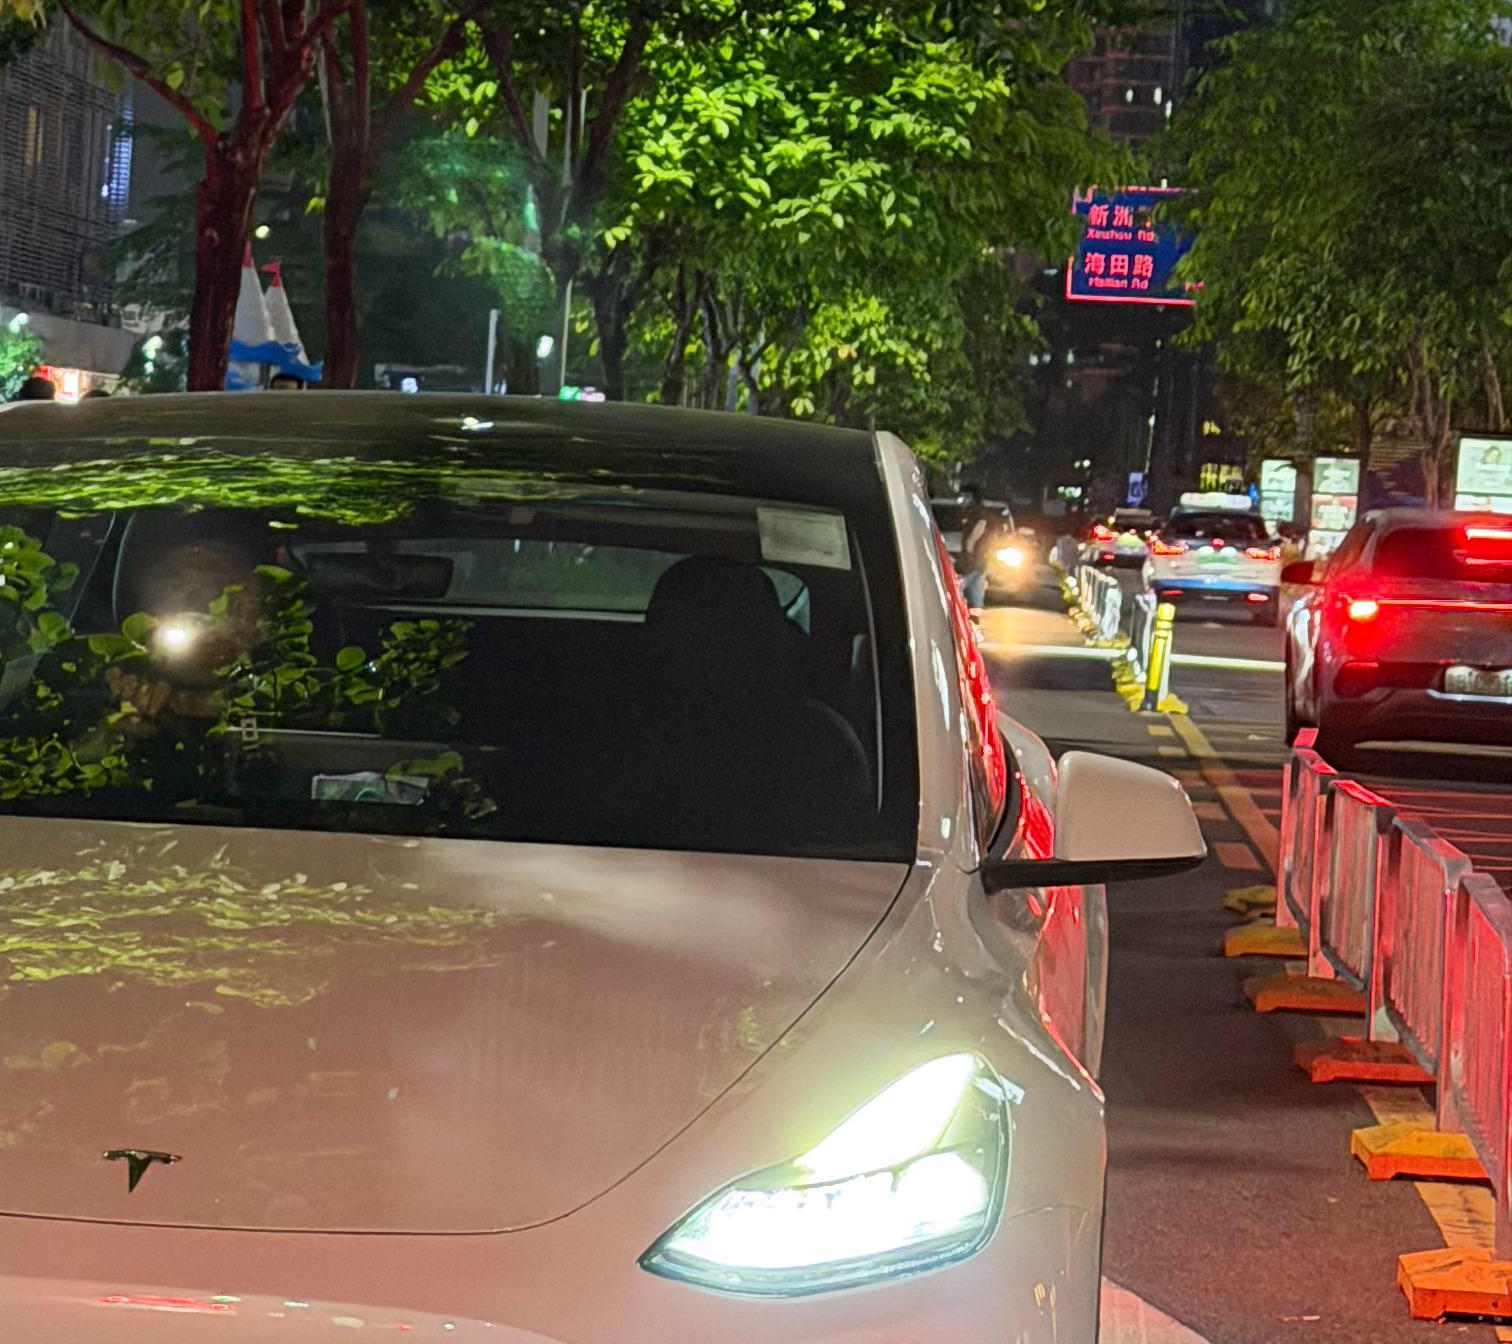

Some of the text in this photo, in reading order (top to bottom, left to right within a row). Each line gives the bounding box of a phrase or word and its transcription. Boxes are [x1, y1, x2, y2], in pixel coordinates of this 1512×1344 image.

[1089, 204, 1152, 228] 新洲
[1085, 252, 1153, 278] 海田路
